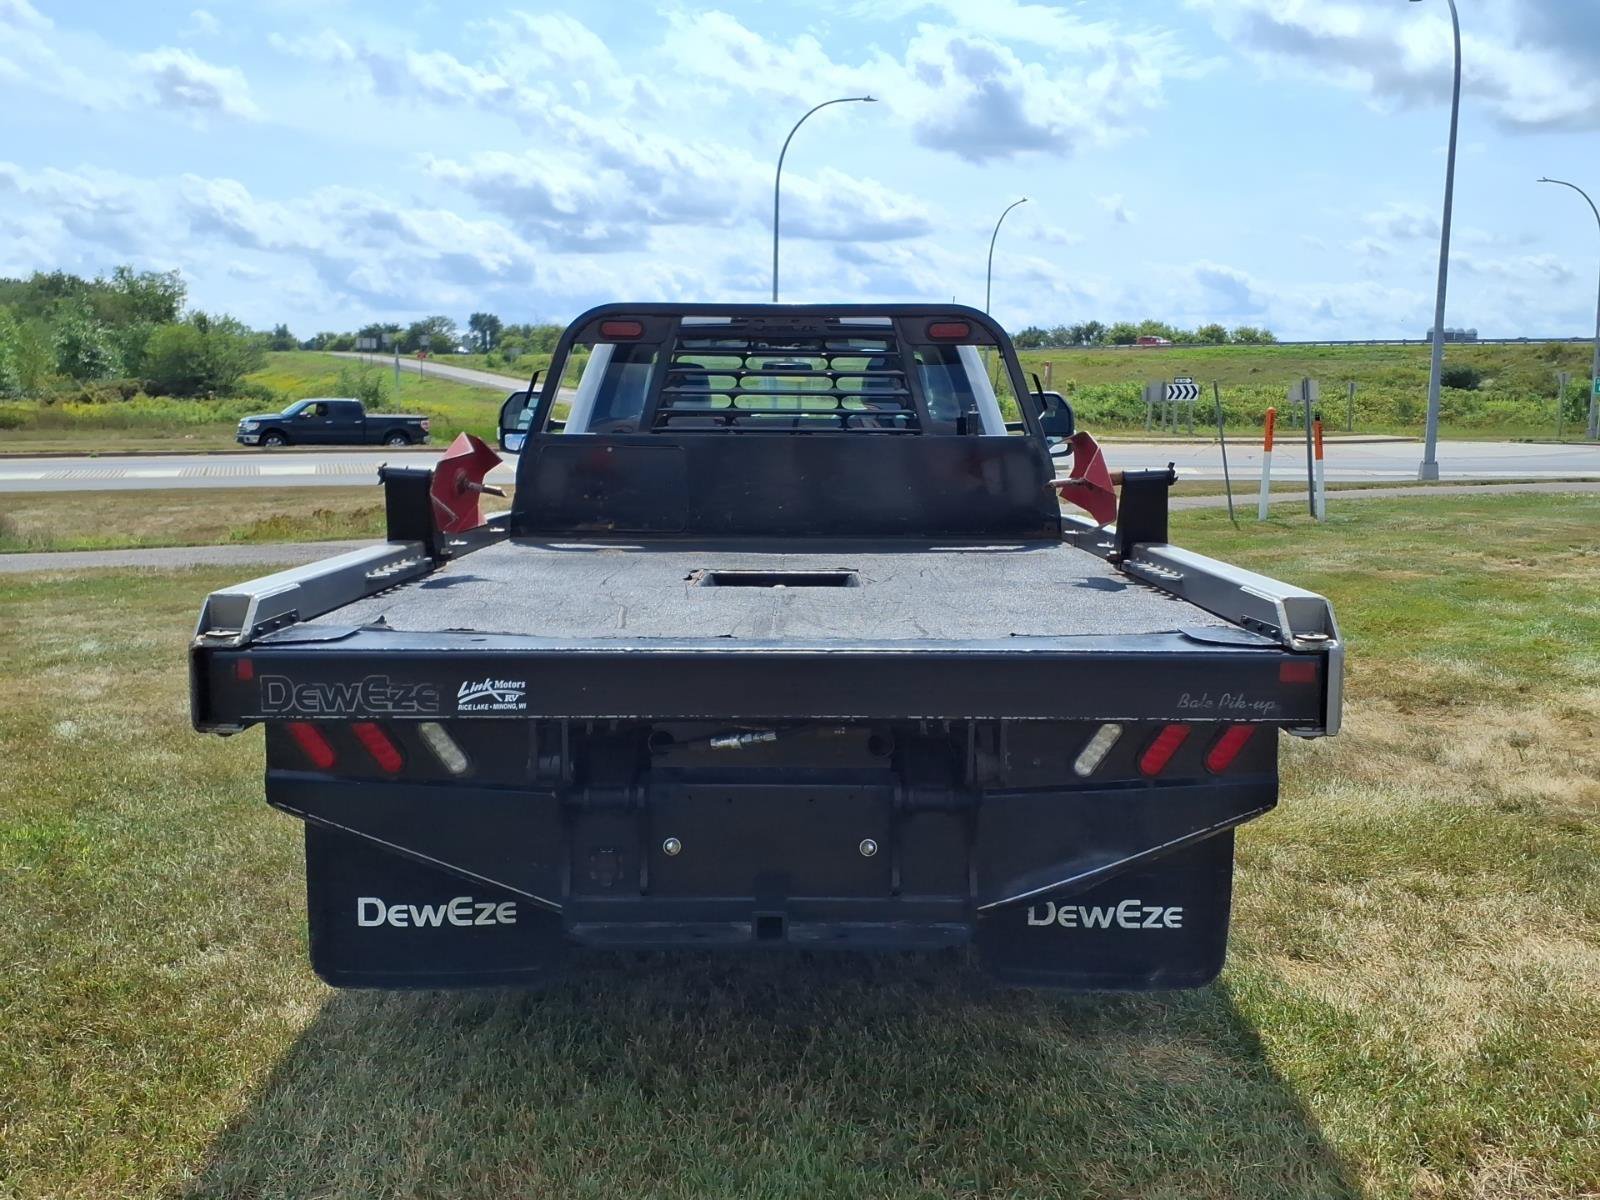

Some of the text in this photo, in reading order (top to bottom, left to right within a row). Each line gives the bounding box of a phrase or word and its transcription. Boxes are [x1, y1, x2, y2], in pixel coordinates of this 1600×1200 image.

[457, 678, 526, 698] Link Motors
[504, 694, 519, 702] RV
[1177, 692, 1213, 708] Bale
[457, 703, 472, 711] RICE
[473, 703, 489, 711] LAKE
